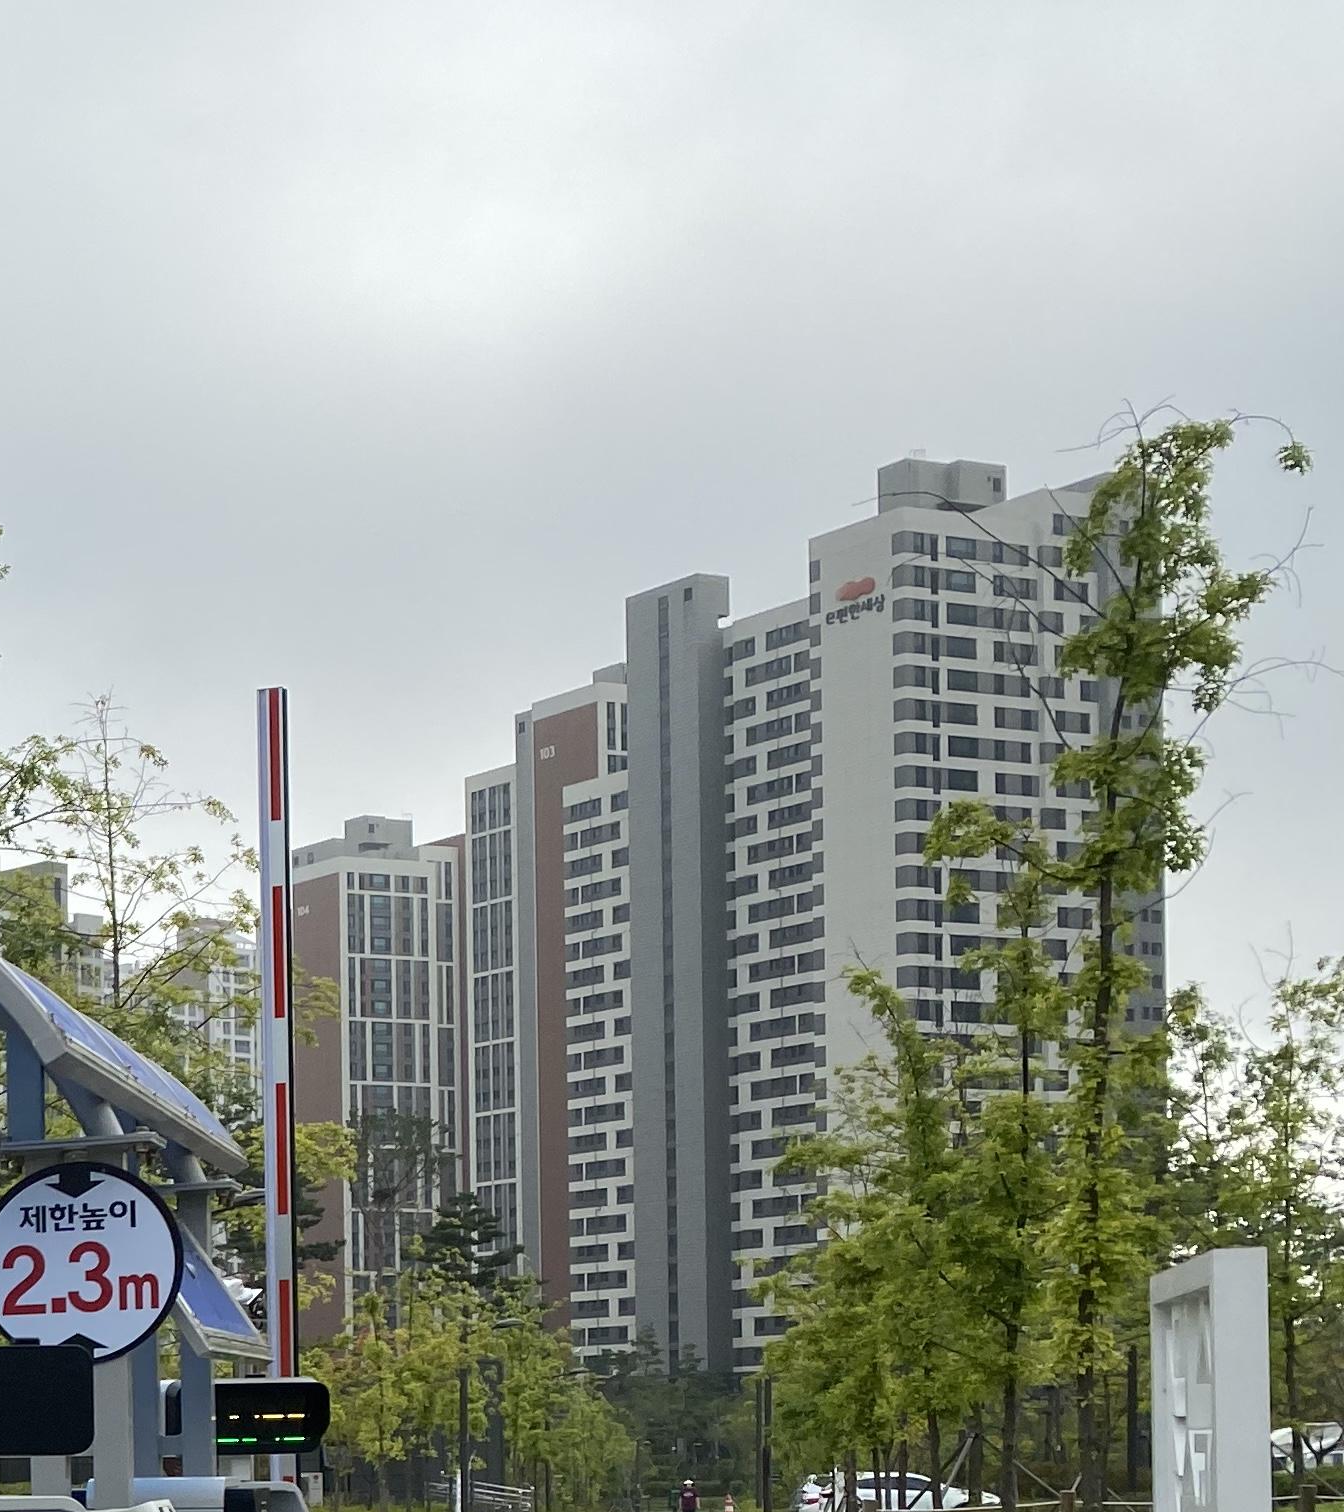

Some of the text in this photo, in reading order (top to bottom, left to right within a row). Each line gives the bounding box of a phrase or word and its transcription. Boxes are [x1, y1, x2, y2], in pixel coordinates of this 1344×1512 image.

[540, 745, 555, 760] 103
[19, 1199, 137, 1234] 제한높이
[1, 1240, 161, 1317] 2.3m
